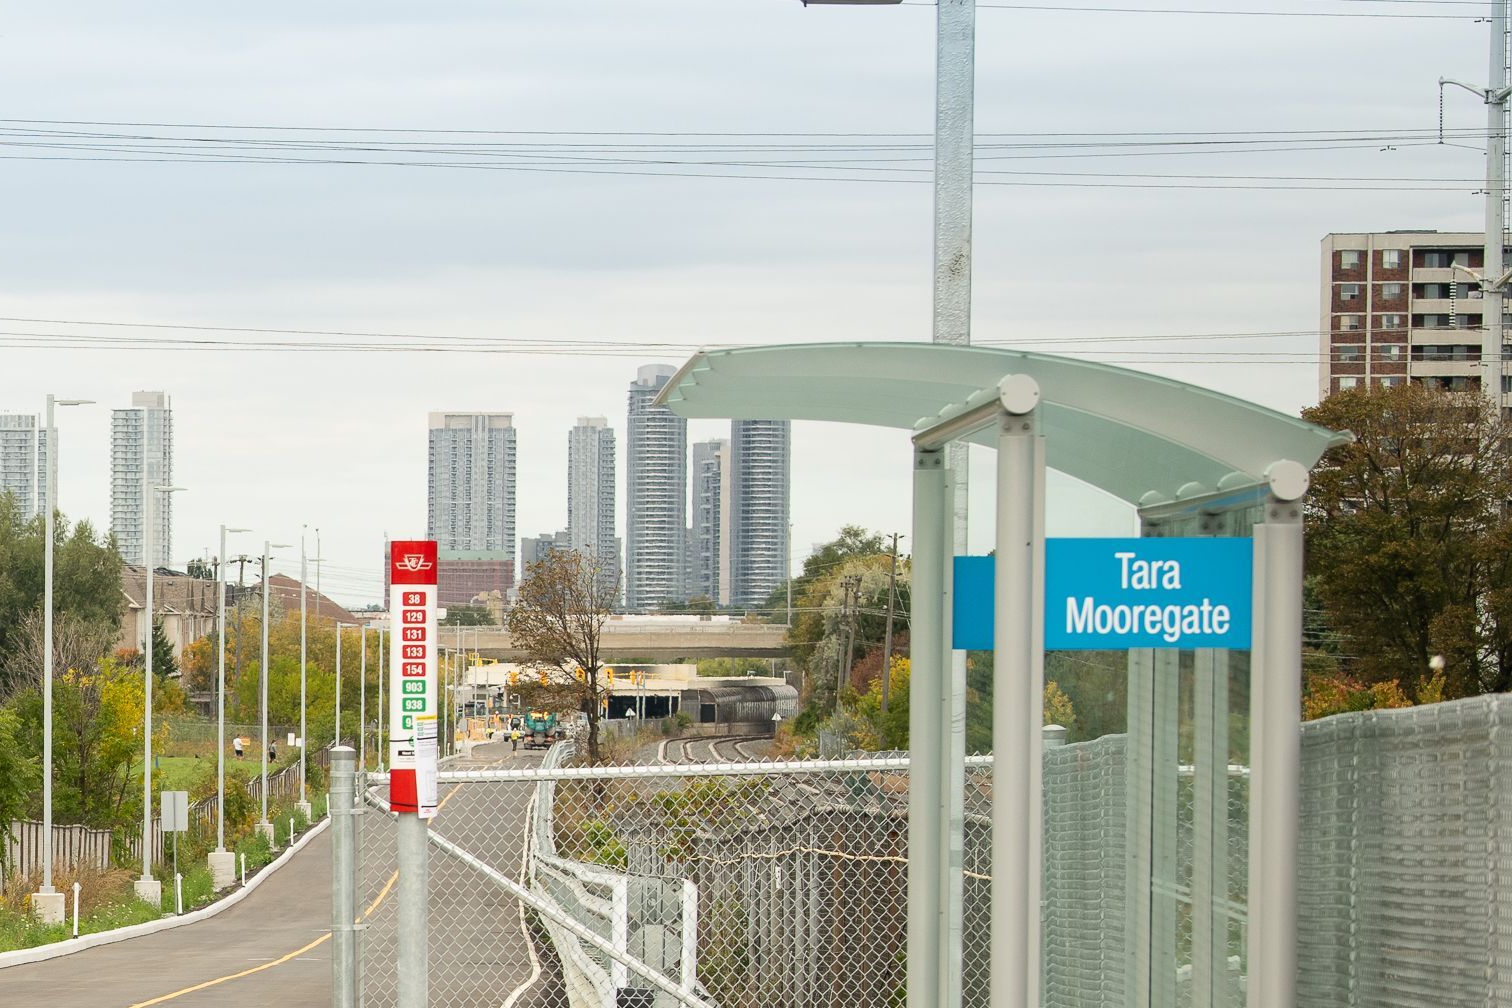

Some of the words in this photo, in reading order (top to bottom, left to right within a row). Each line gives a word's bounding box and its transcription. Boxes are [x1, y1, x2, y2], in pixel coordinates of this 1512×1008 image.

[1114, 552, 1182, 590] Tara
[408, 594, 421, 604] 38
[406, 612, 423, 622] 129
[1066, 597, 1231, 643] Mooregate
[406, 629, 423, 640] 131
[406, 647, 423, 657] 133
[406, 664, 423, 674] 154
[406, 682, 423, 692] 903
[406, 700, 423, 710] 938
